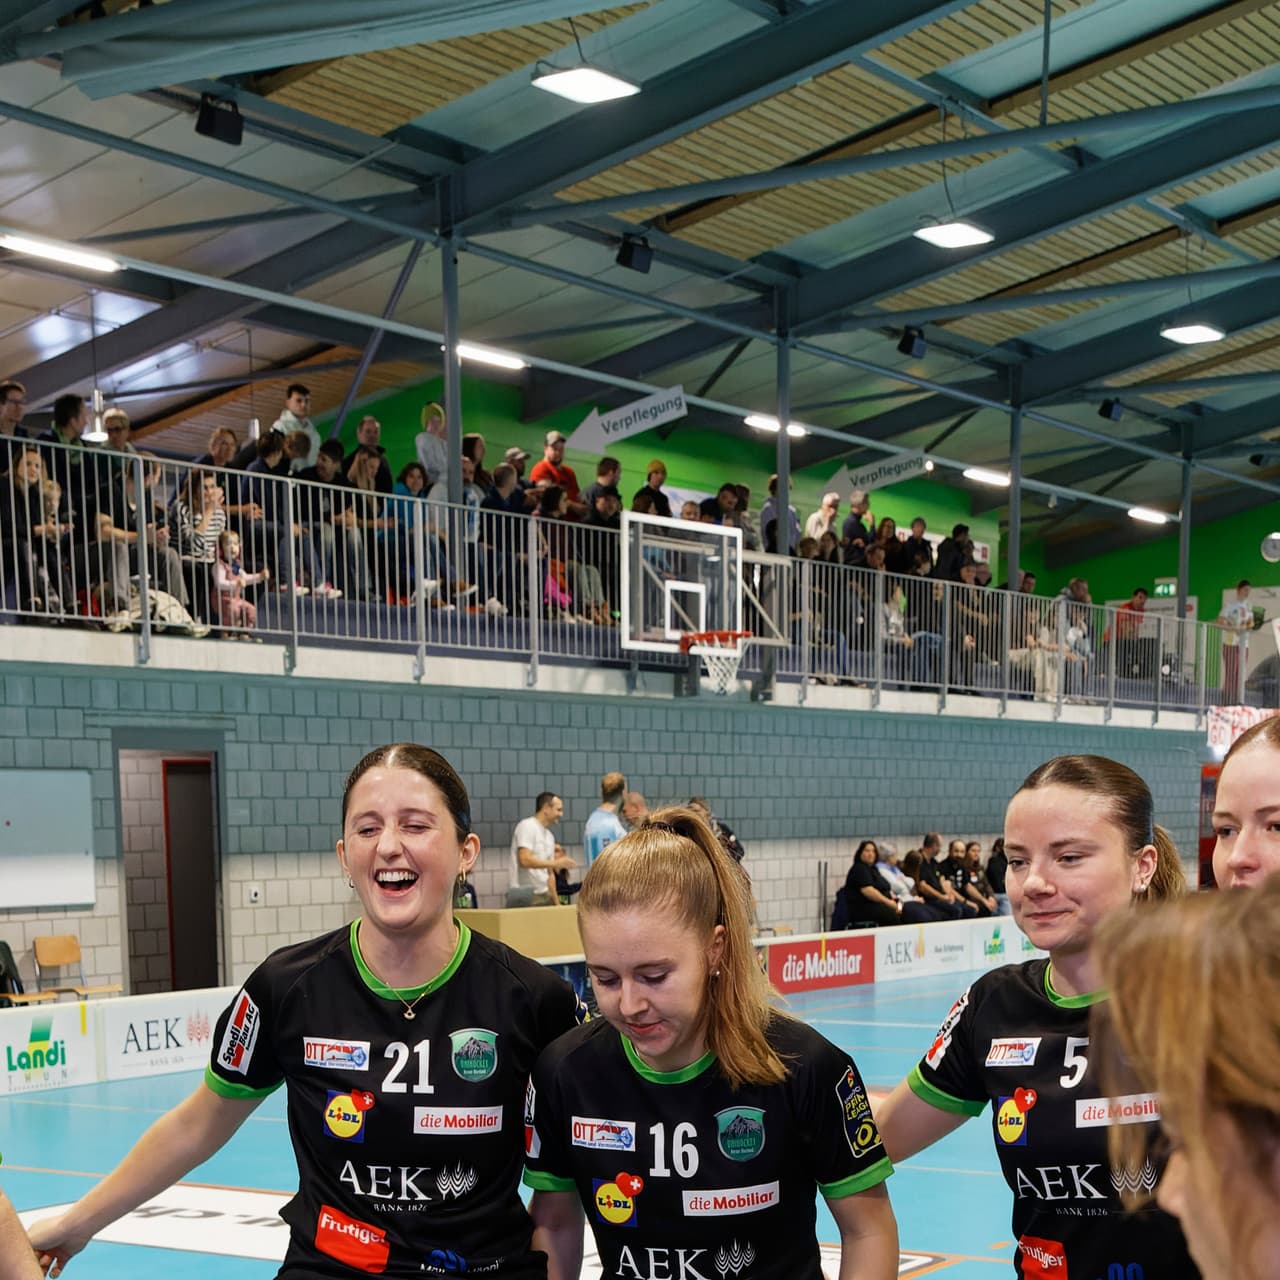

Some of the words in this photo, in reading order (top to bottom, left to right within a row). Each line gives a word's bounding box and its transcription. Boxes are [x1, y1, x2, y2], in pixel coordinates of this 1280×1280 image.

[600, 392, 683, 435] Verpflegung
[849, 456, 922, 489] Verpflegung
[782, 958, 802, 983] die
[805, 949, 862, 981] Mobiliar
[884, 940, 912, 965] AEK
[122, 1017, 184, 1054] AEK
[223, 1025, 241, 1065] Spedi
[306, 1042, 327, 1061] OTT
[7, 1039, 66, 1072] Landi
[381, 1039, 435, 1094] 21
[1060, 1036, 1090, 1088] 5
[420, 1112, 442, 1128] die
[444, 1111, 498, 1129] Mobiliar
[1082, 1105, 1105, 1121] die
[1108, 1094, 1161, 1118] Mobili
[574, 1121, 596, 1142] OTT
[649, 1122, 699, 1178] 16
[339, 1160, 432, 1200] AEK
[1016, 1164, 1108, 1201] AEK
[689, 1196, 711, 1212] die
[713, 1189, 774, 1210] Mobiliar
[1086, 1207, 1108, 1216] 1826
